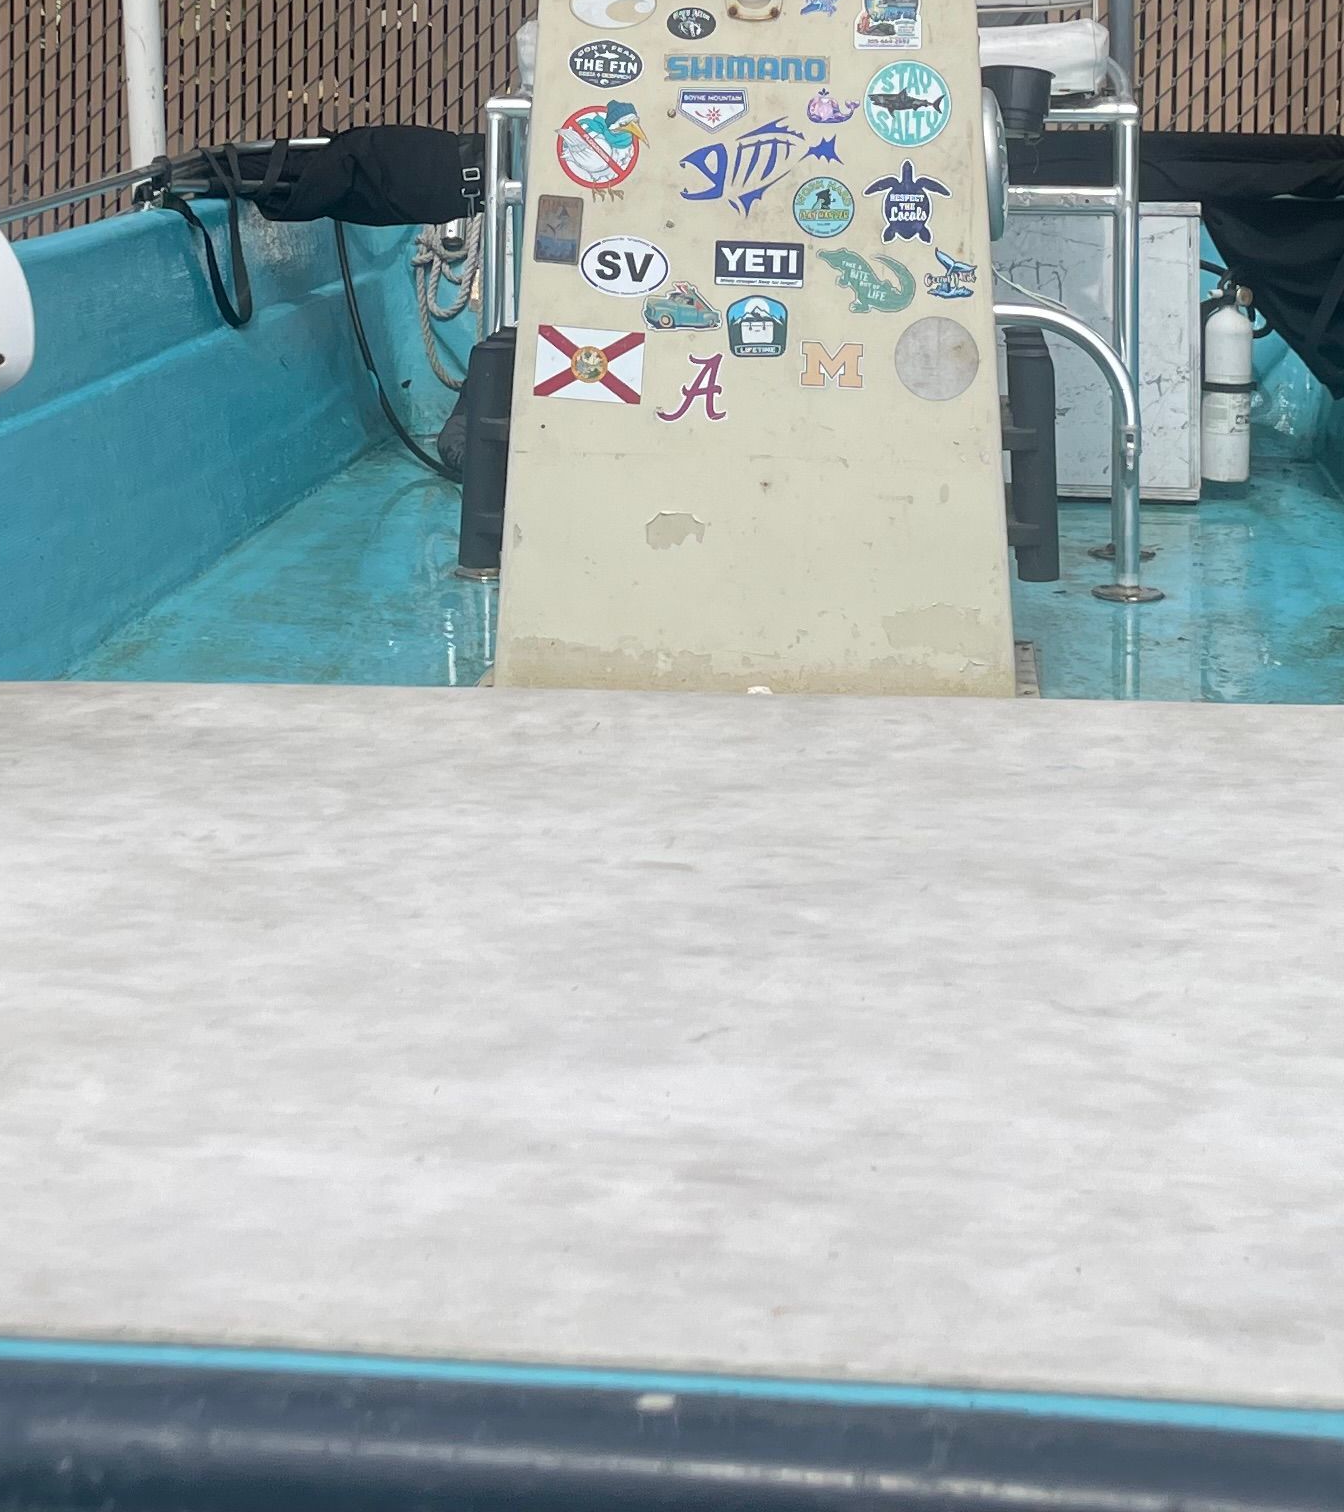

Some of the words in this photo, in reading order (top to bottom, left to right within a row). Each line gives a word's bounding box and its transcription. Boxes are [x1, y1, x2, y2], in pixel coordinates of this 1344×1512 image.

[577, 45, 607, 57] DON'T
[611, 45, 636, 61] FEAR
[574, 58, 604, 71] THE
[609, 61, 638, 74] FIN
[667, 55, 826, 82] SHIMANO
[881, 67, 932, 95] STAY
[876, 110, 939, 141] SALTY
[889, 193, 925, 202] RESPECT
[889, 206, 927, 221] Locals
[899, 202, 916, 211] THE
[595, 250, 654, 283] SV
[720, 247, 797, 274] YETI
[849, 268, 870, 282] BITE
[867, 288, 887, 302] LIFE
[740, 346, 776, 354] LIFETIME
[801, 341, 864, 388] M
[656, 353, 726, 421] A
